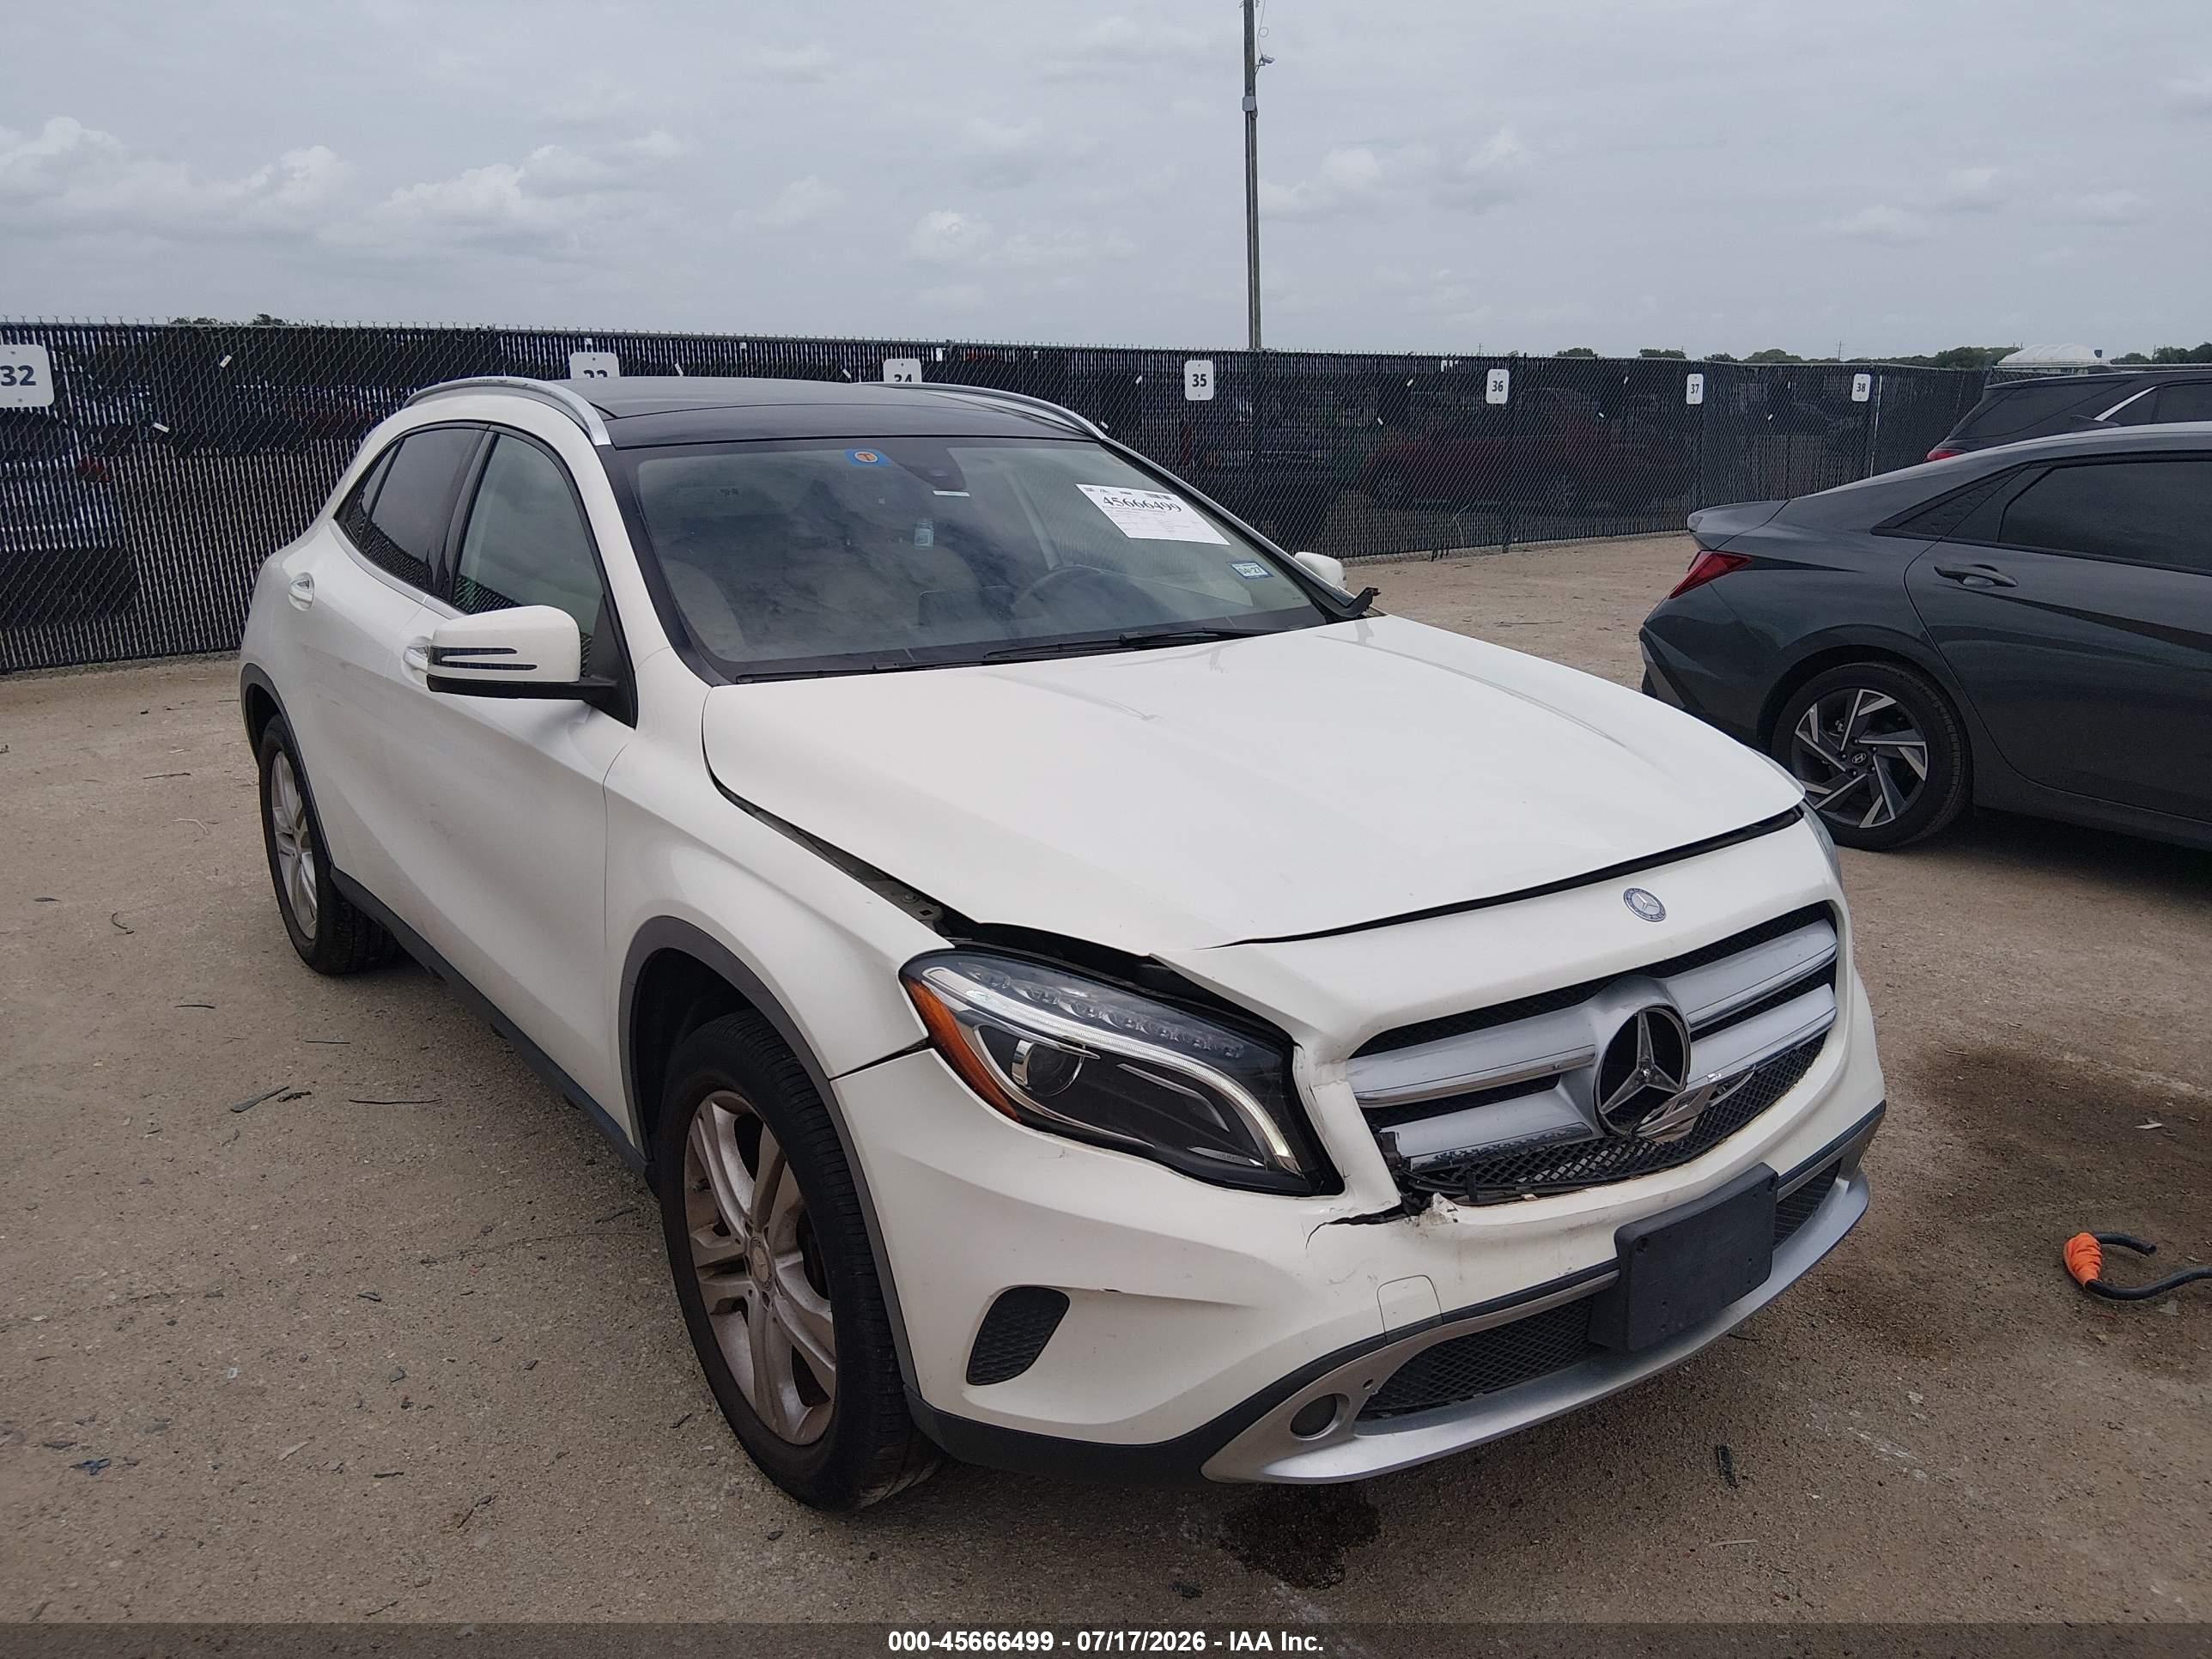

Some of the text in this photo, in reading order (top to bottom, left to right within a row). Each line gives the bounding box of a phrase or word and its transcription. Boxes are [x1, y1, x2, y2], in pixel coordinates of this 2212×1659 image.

[0, 365, 37, 386] 32
[1192, 374, 1207, 387] 35
[1492, 380, 1504, 392] 36
[1691, 383, 1699, 394] 37
[1856, 382, 1866, 392] 38
[1103, 496, 1182, 513] 45666499
